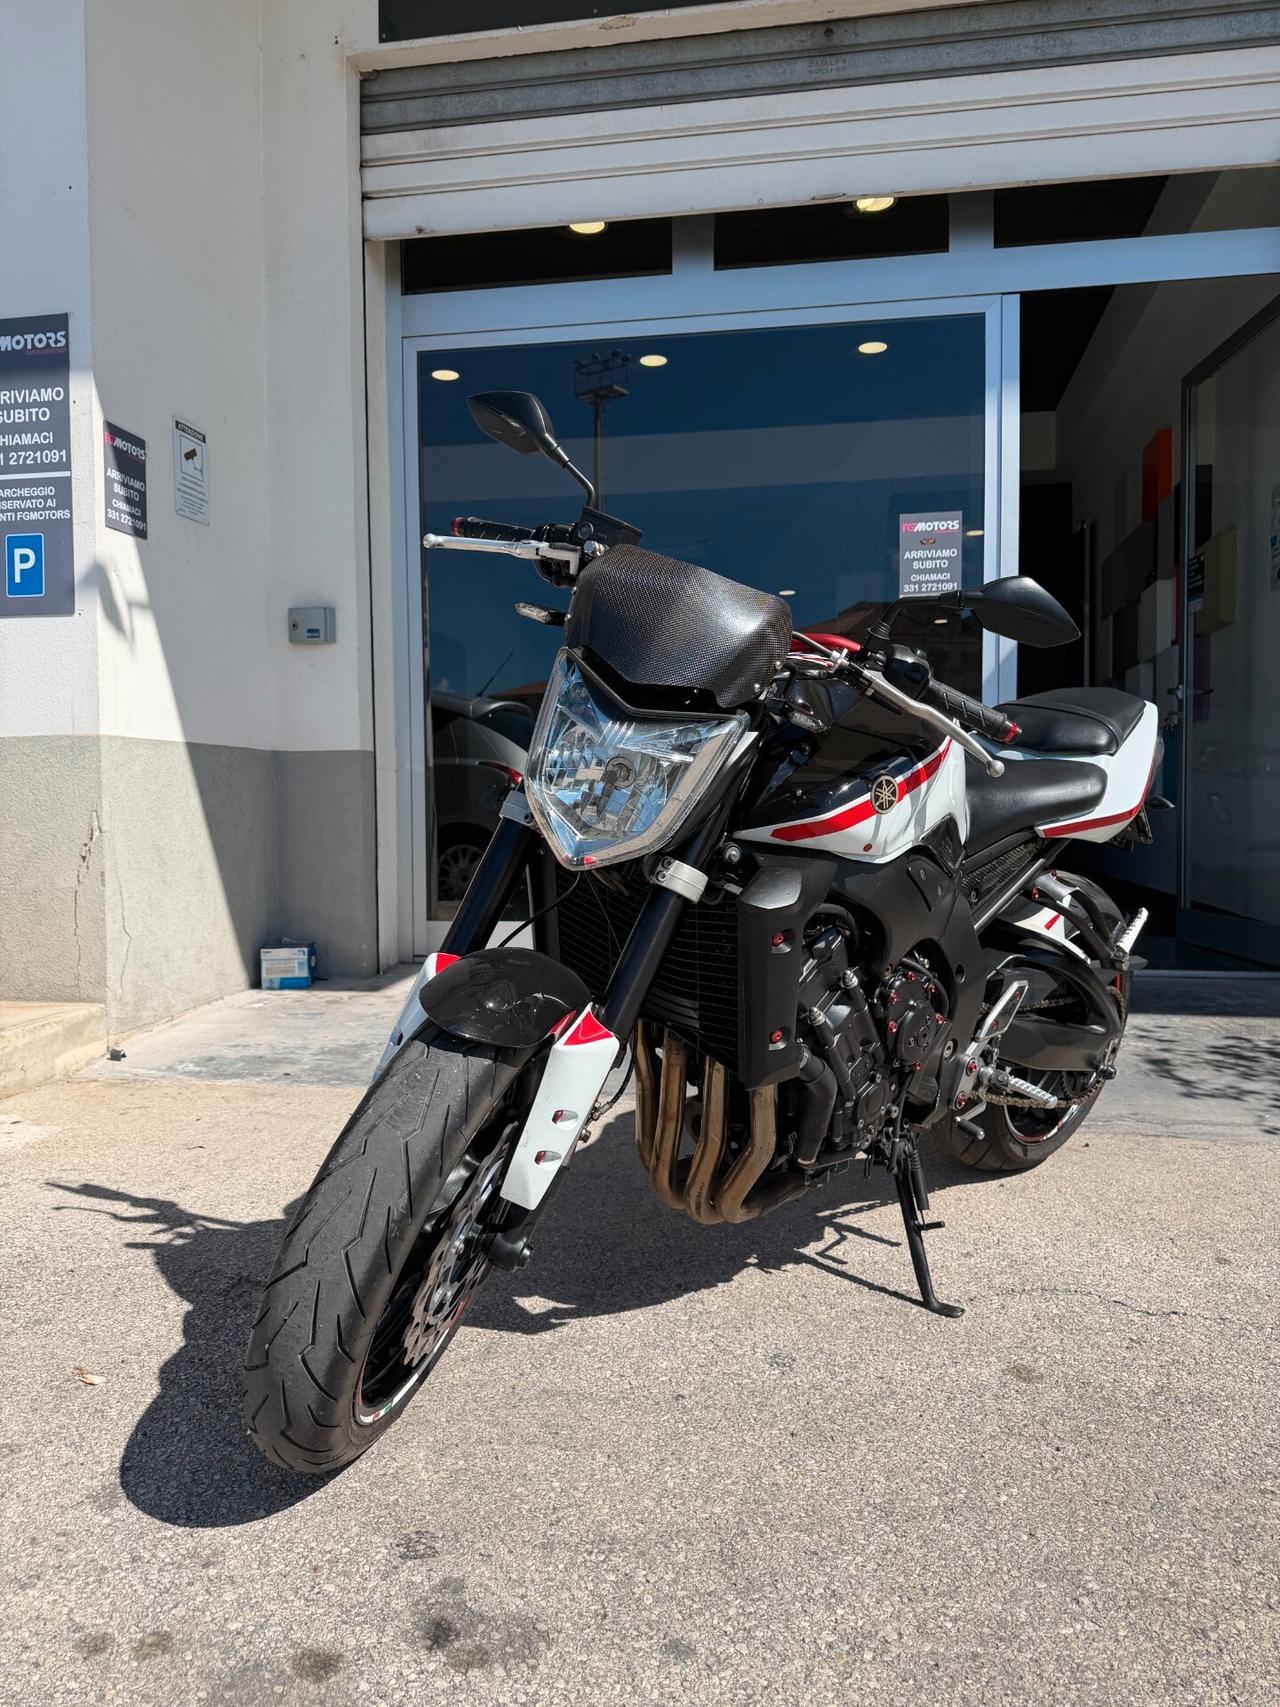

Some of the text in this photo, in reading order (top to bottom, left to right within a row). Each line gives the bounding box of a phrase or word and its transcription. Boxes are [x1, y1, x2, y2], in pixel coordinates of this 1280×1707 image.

[0, 387, 64, 404] RIVIAMO
[0, 432, 53, 446] HIAMACI
[9, 449, 67, 465] 2721091
[106, 467, 145, 491] ARRIVIAMO
[113, 482, 140, 501] SUBITO
[46, 498, 56, 508] AI
[17, 510, 71, 521] FGMOTORS
[107, 508, 147, 531] 331 2721091
[903, 548, 957, 559] ARRIVIAMO
[13, 548, 36, 584] P
[913, 559, 949, 569] SUBITO
[910, 573, 950, 582] CHIAMACI
[903, 582, 957, 593] 331 2721091
